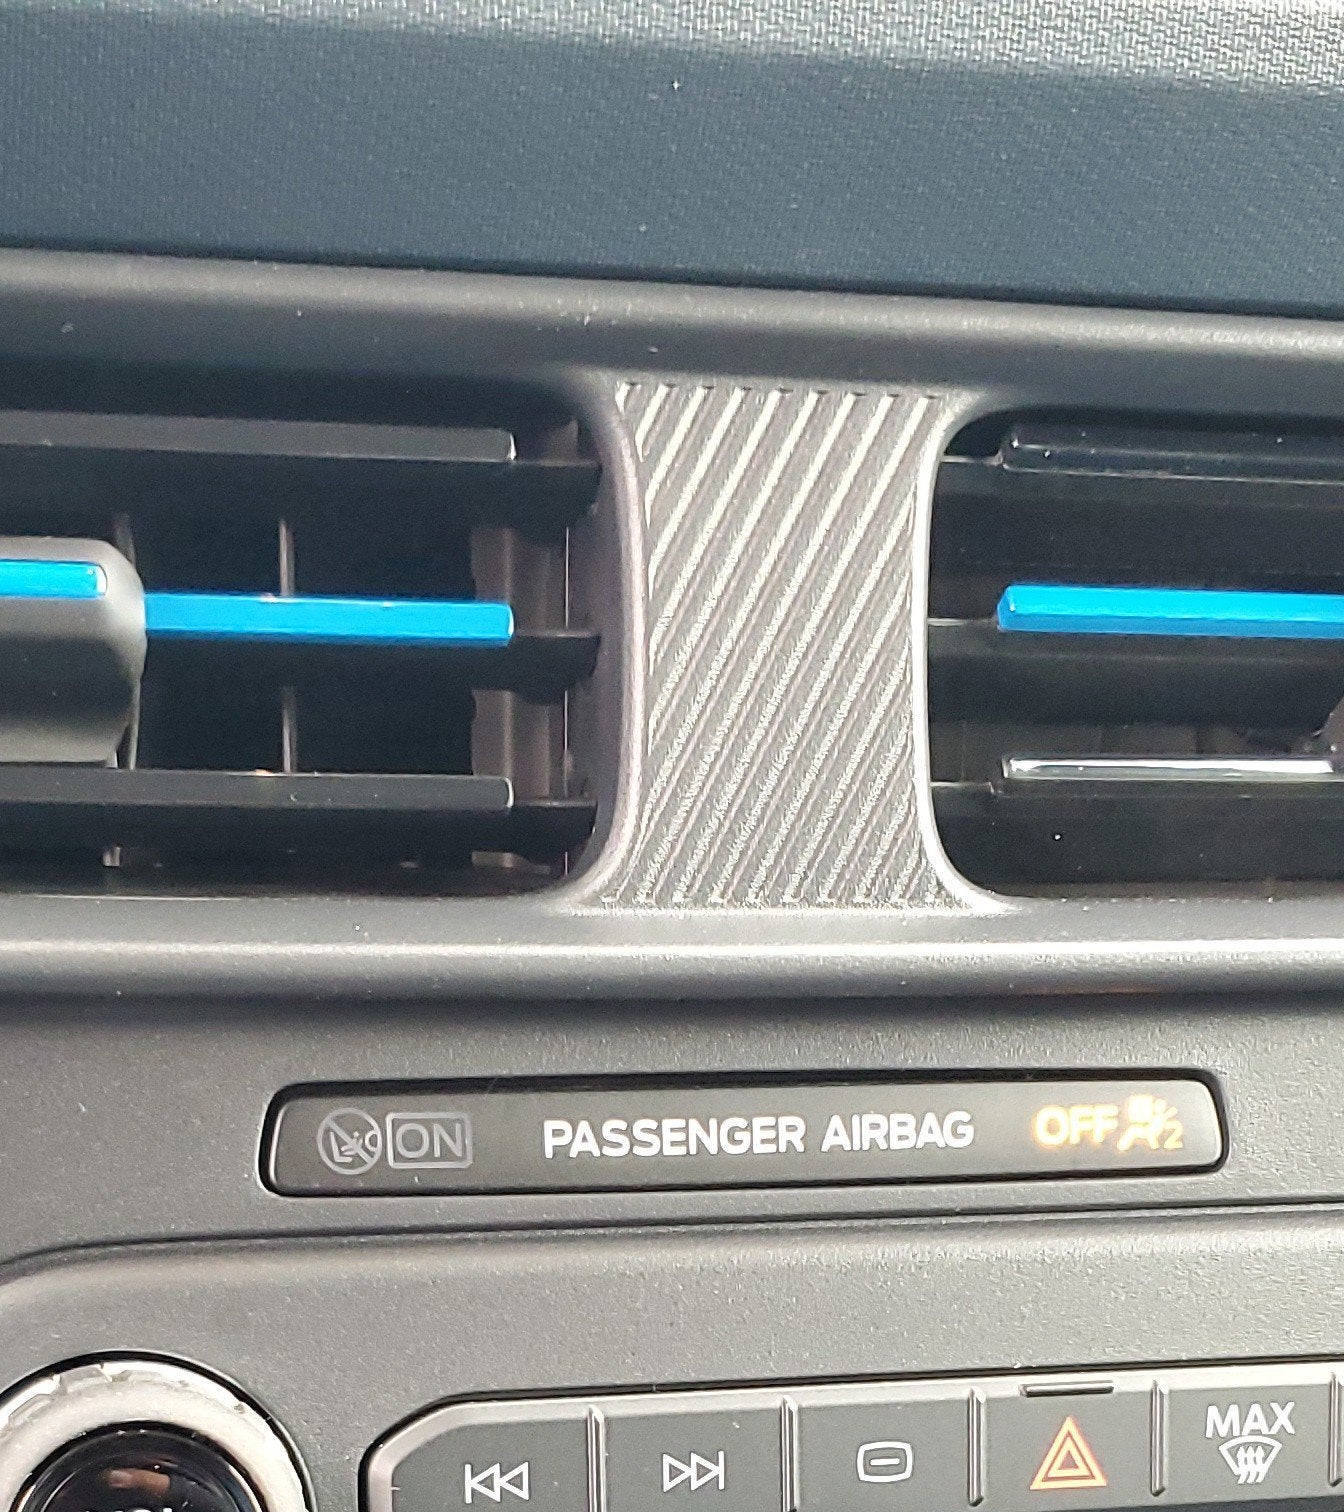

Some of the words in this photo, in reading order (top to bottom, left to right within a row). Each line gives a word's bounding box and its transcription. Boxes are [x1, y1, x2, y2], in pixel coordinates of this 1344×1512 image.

[396, 1122, 463, 1159] ON
[542, 1114, 806, 1159] PASSENGER
[820, 1110, 976, 1152] AIRBAG
[1035, 1105, 1119, 1145] OFF
[1205, 1401, 1296, 1439] MAX
